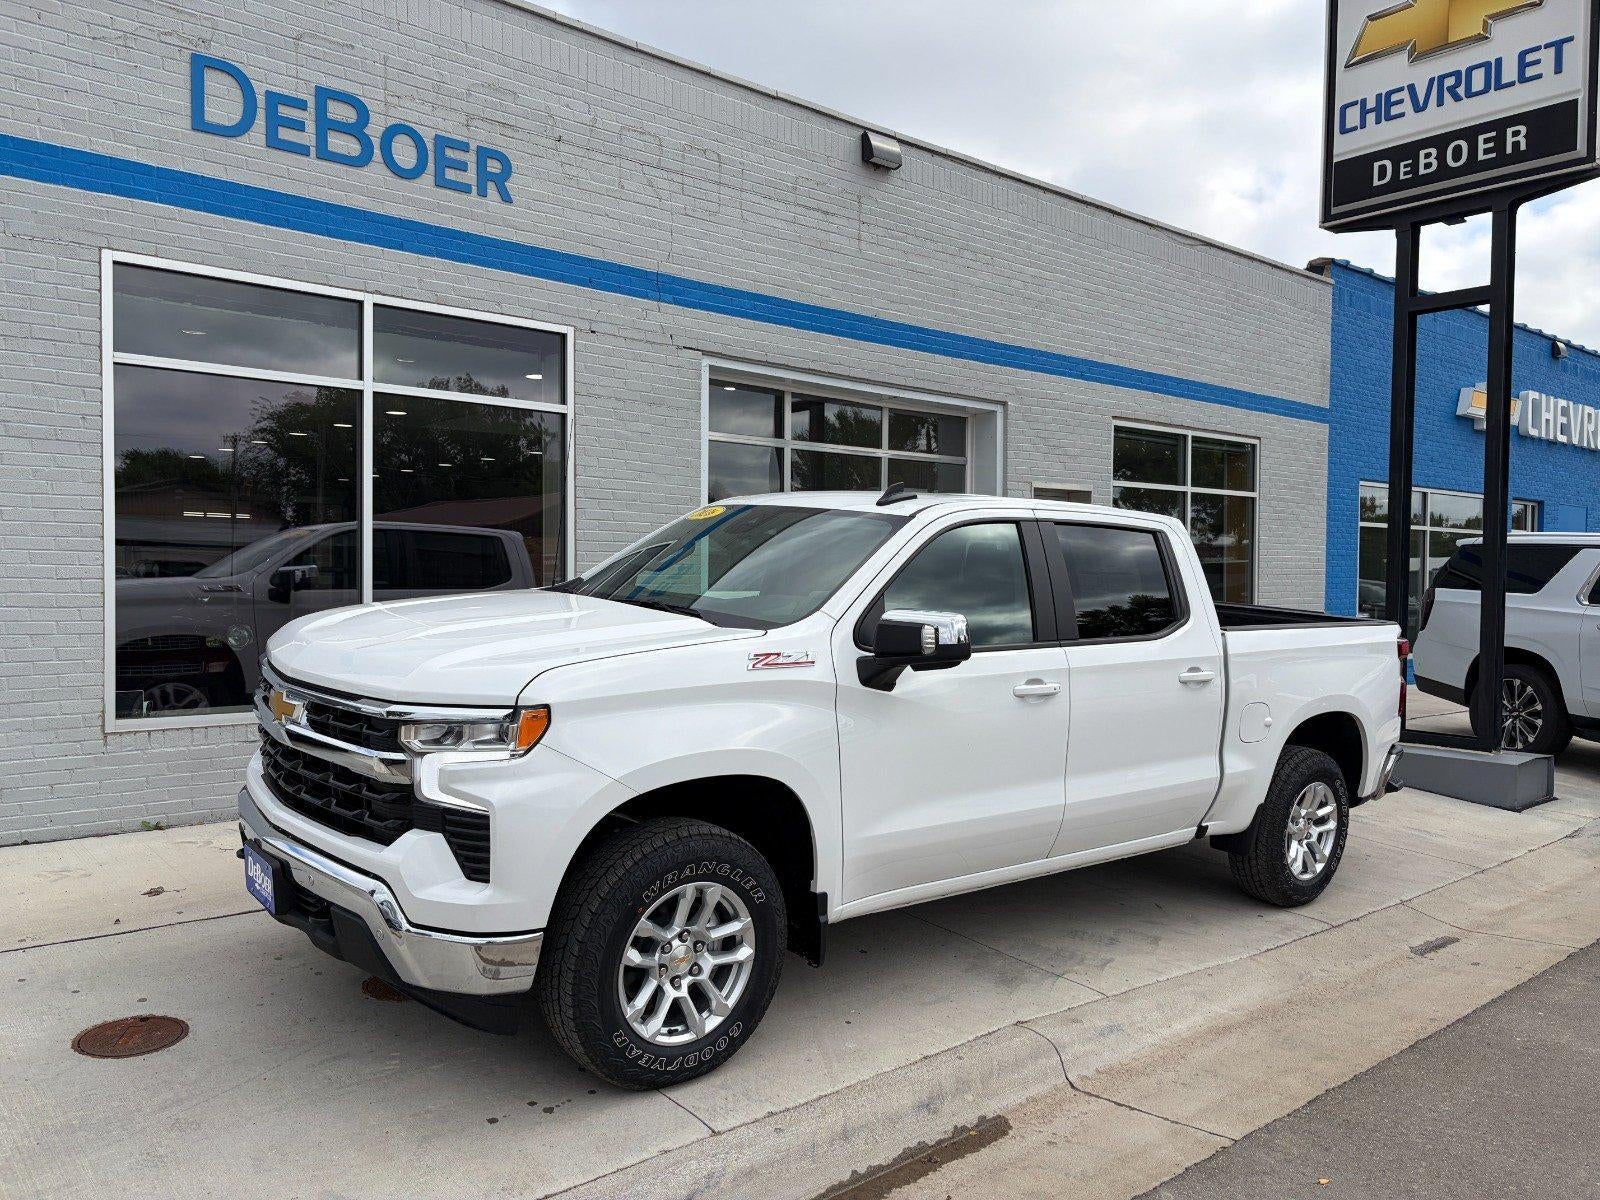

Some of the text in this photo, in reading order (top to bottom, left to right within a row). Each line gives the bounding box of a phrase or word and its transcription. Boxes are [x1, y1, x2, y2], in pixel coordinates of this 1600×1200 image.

[1339, 35, 1575, 135] CHEVROLET
[1519, 390, 1600, 450] CHEVR
[642, 861, 766, 904] WRANGLER
[612, 1021, 743, 1071] GOODYEAR
